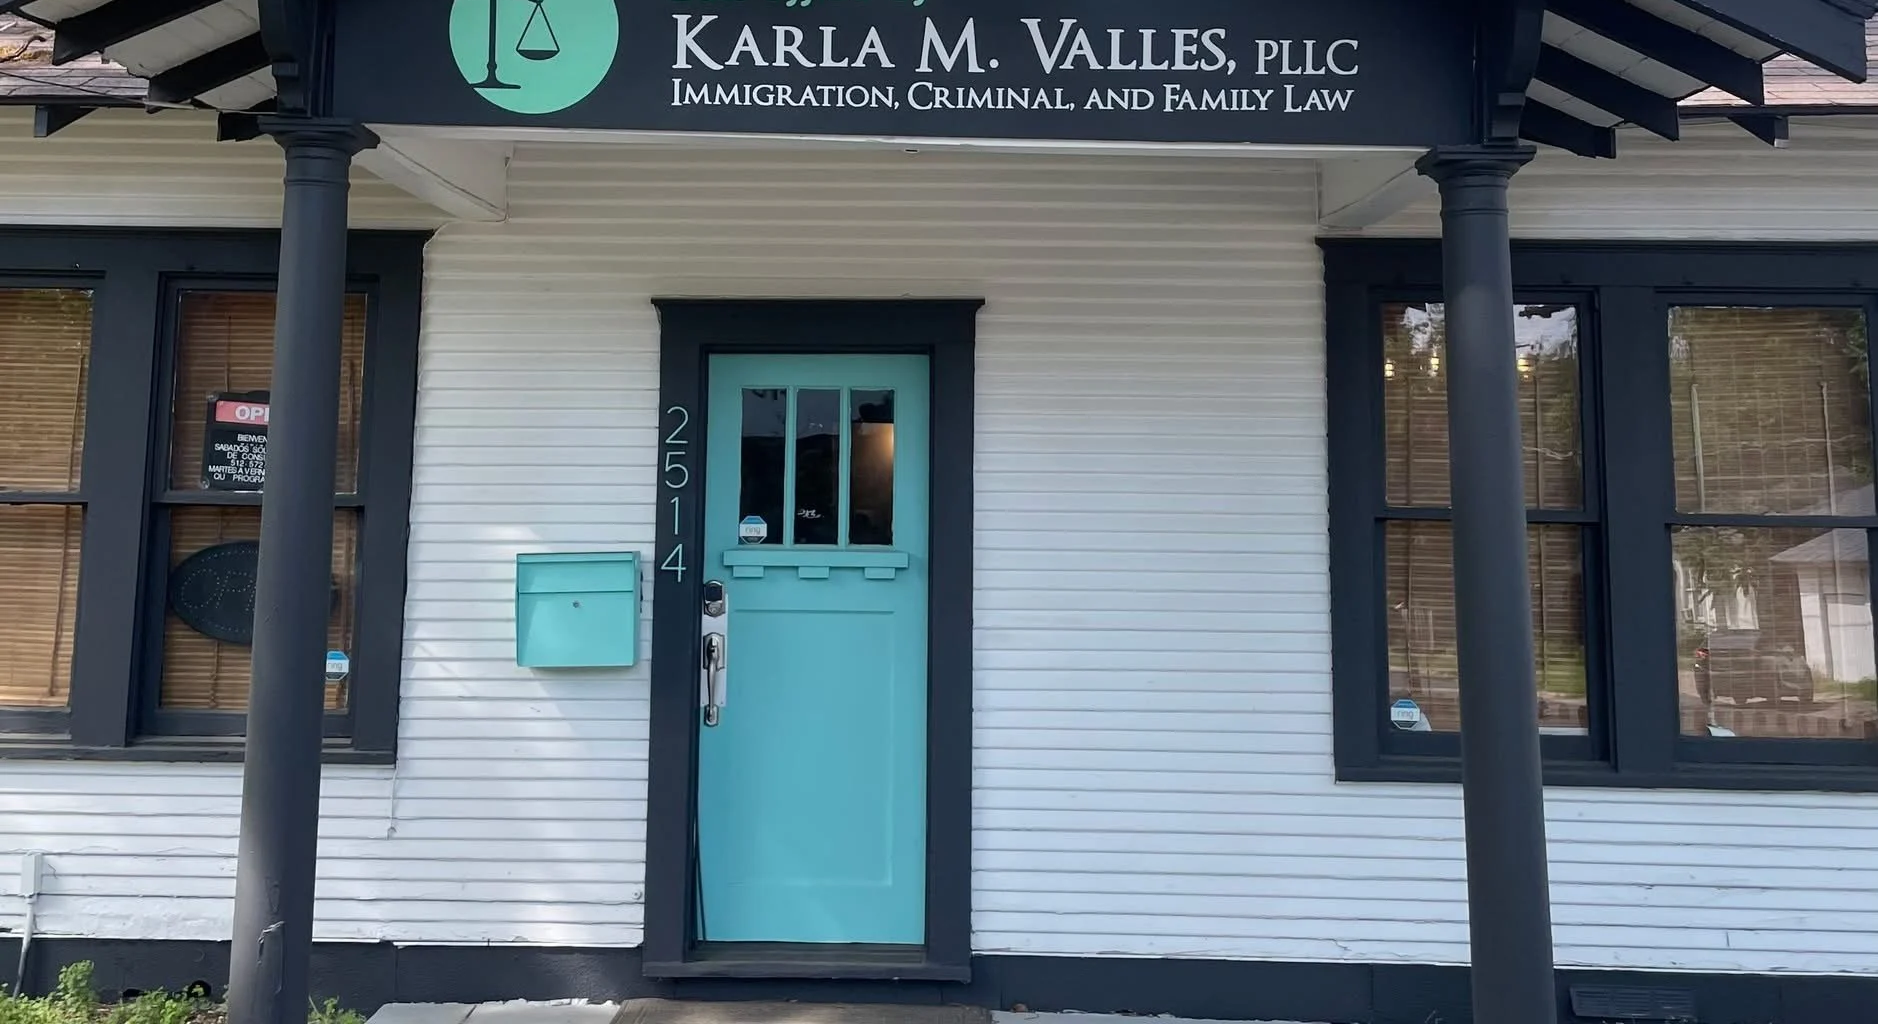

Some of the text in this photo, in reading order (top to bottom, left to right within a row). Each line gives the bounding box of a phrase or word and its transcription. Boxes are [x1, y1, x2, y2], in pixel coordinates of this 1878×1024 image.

[671, 14, 1359, 75] KARLA M. VALLES, PLLC
[671, 78, 1355, 113] IMMIGRATION, CRIMINAL, AND FAMILY LAW
[226, 451, 266, 463] DE CONS
[660, 406, 689, 582] 2514
